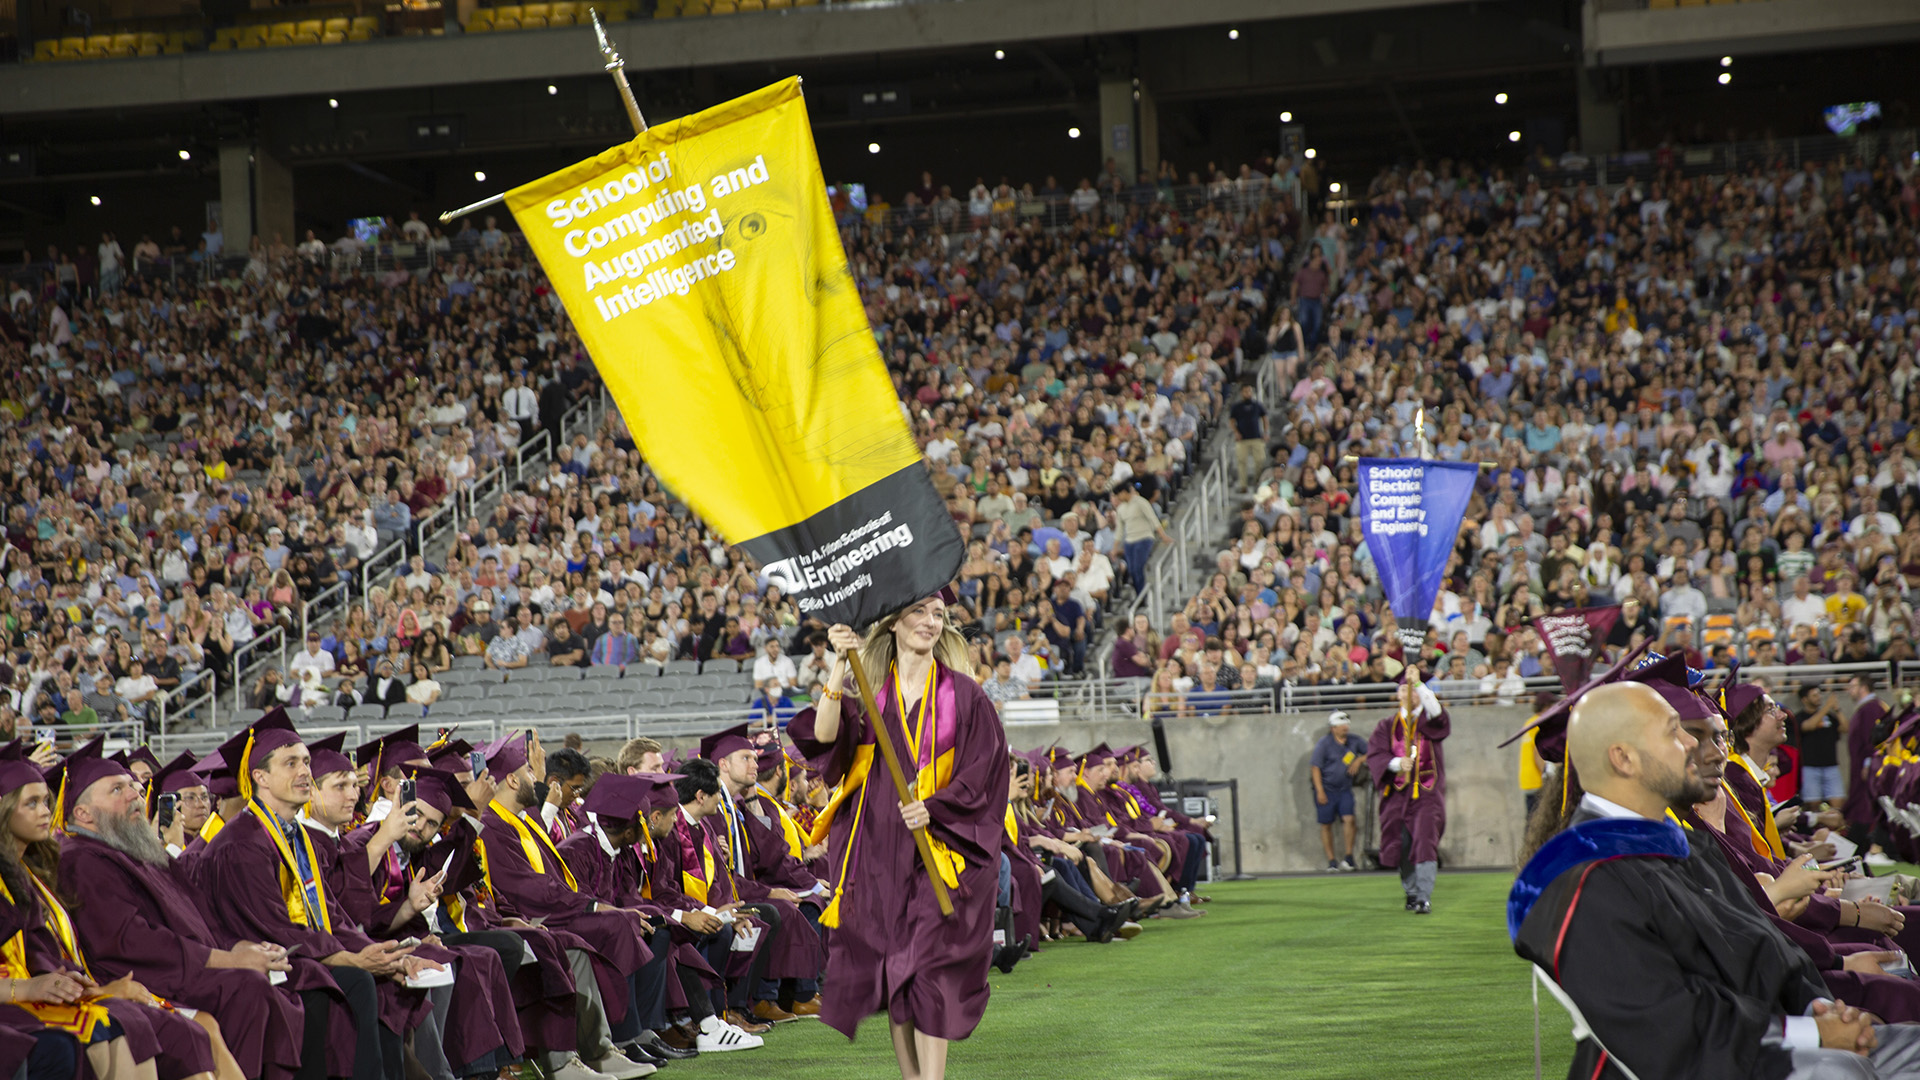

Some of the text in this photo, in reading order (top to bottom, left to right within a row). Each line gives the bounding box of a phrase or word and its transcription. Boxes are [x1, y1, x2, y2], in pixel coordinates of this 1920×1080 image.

[546, 151, 673, 228] School of
[564, 154, 770, 257] Computing and
[583, 208, 724, 292] Augmented
[594, 248, 736, 322] Intelligence
[1370, 507, 1395, 520] and
[803, 523, 913, 590] Engineering
